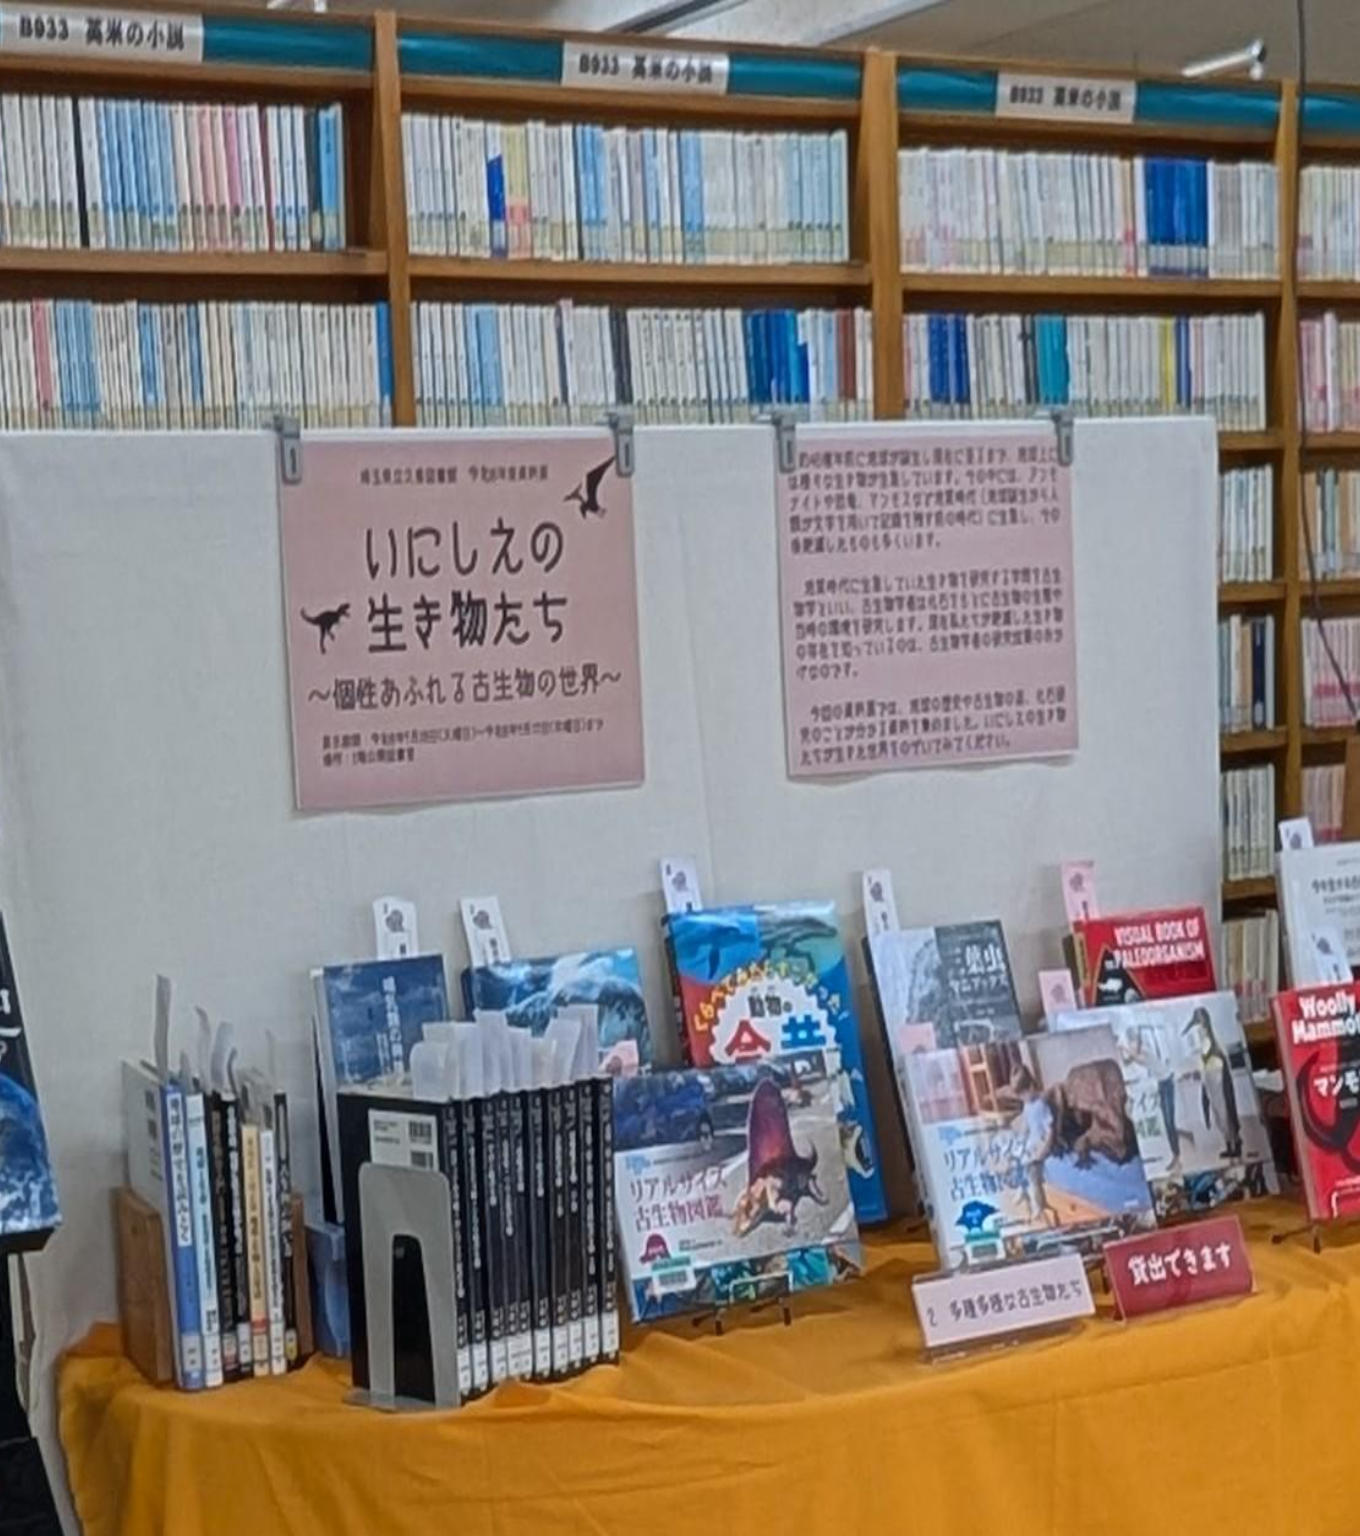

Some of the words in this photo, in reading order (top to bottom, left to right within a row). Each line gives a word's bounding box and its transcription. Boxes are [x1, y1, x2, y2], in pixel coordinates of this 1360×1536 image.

[85, 16, 184, 51] 英米の小説
[365, 517, 563, 579] いにしえの
[367, 590, 568, 653] 生き物たち
[1114, 924, 1153, 948] VISUAL
[1155, 921, 1183, 943] BOOK
[1186, 917, 1200, 938] OF
[1299, 990, 1356, 1019] Woolly
[630, 1166, 727, 1201] リアルサイズ
[635, 1194, 724, 1231] 古生物図鑑
[1127, 1241, 1232, 1286] 貸出できます
[949, 1279, 1084, 1321] 多種多様な古生物たち
